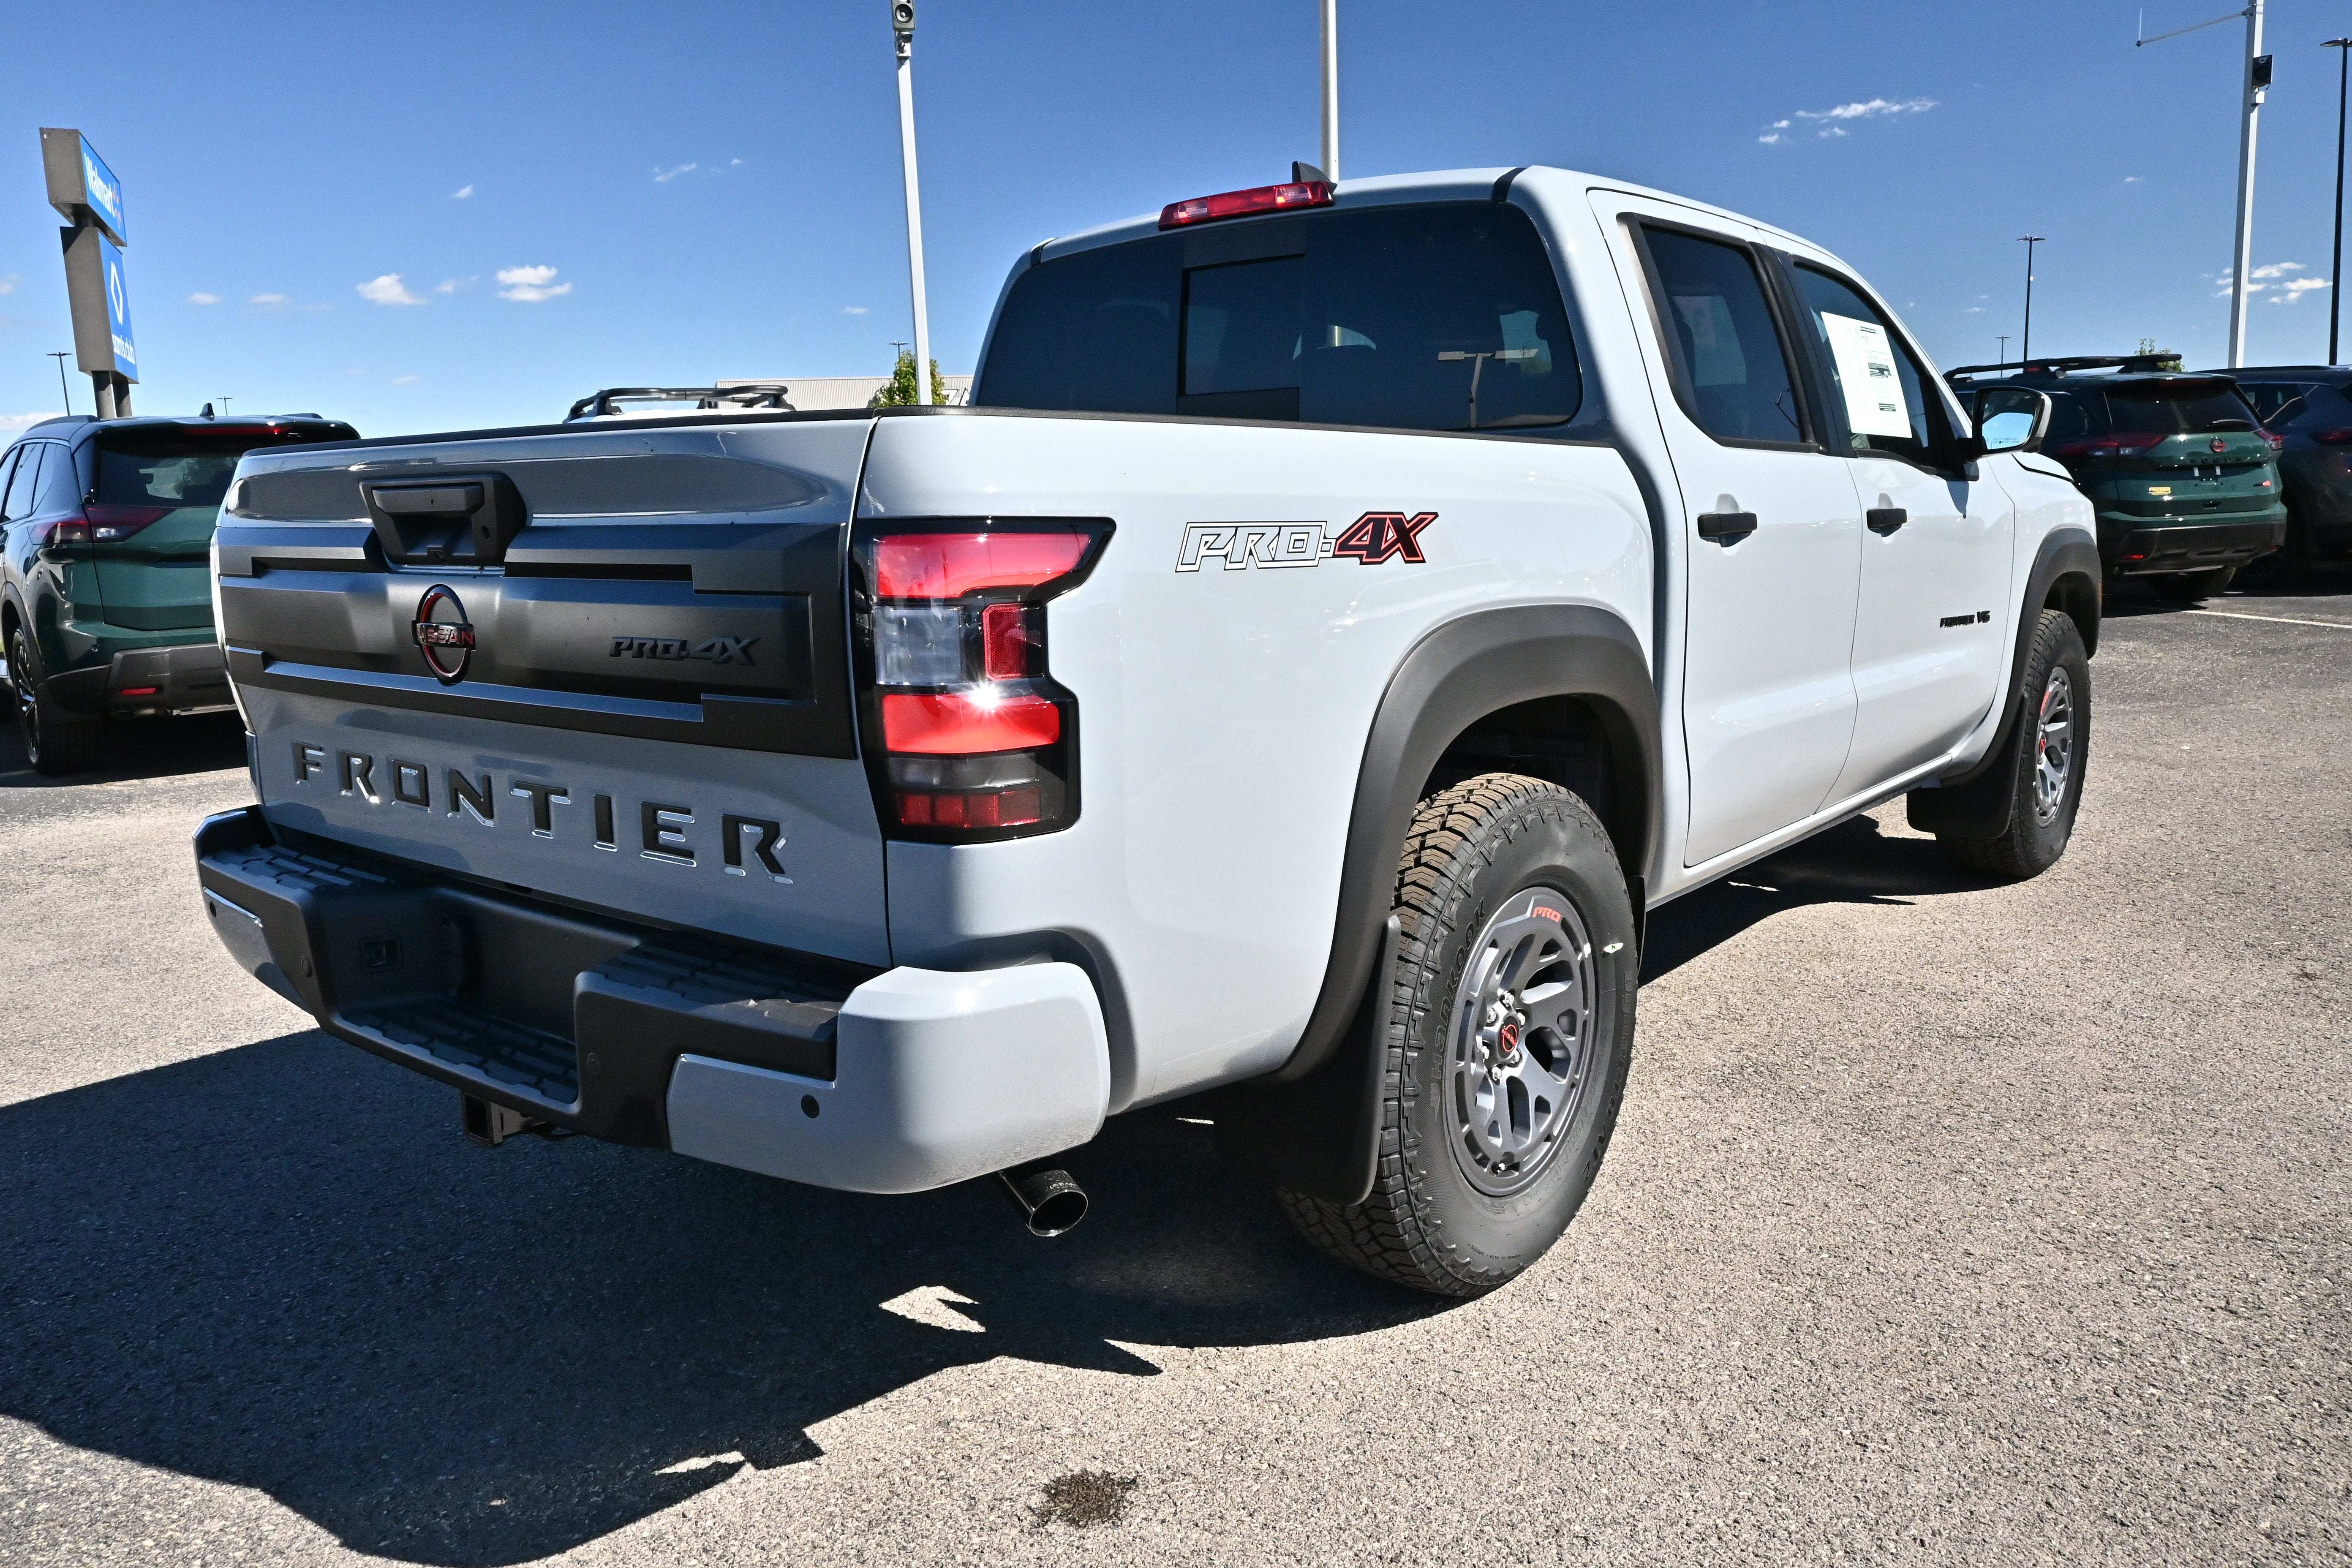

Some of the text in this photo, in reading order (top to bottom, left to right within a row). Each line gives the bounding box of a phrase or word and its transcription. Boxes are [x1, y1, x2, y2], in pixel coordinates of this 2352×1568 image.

[84, 152, 115, 217] Walmart
[112, 333, 135, 364] sam's club
[417, 625, 474, 645] NISSAN
[292, 741, 793, 885] FRONTIER
[1533, 907, 1562, 923] PRO
